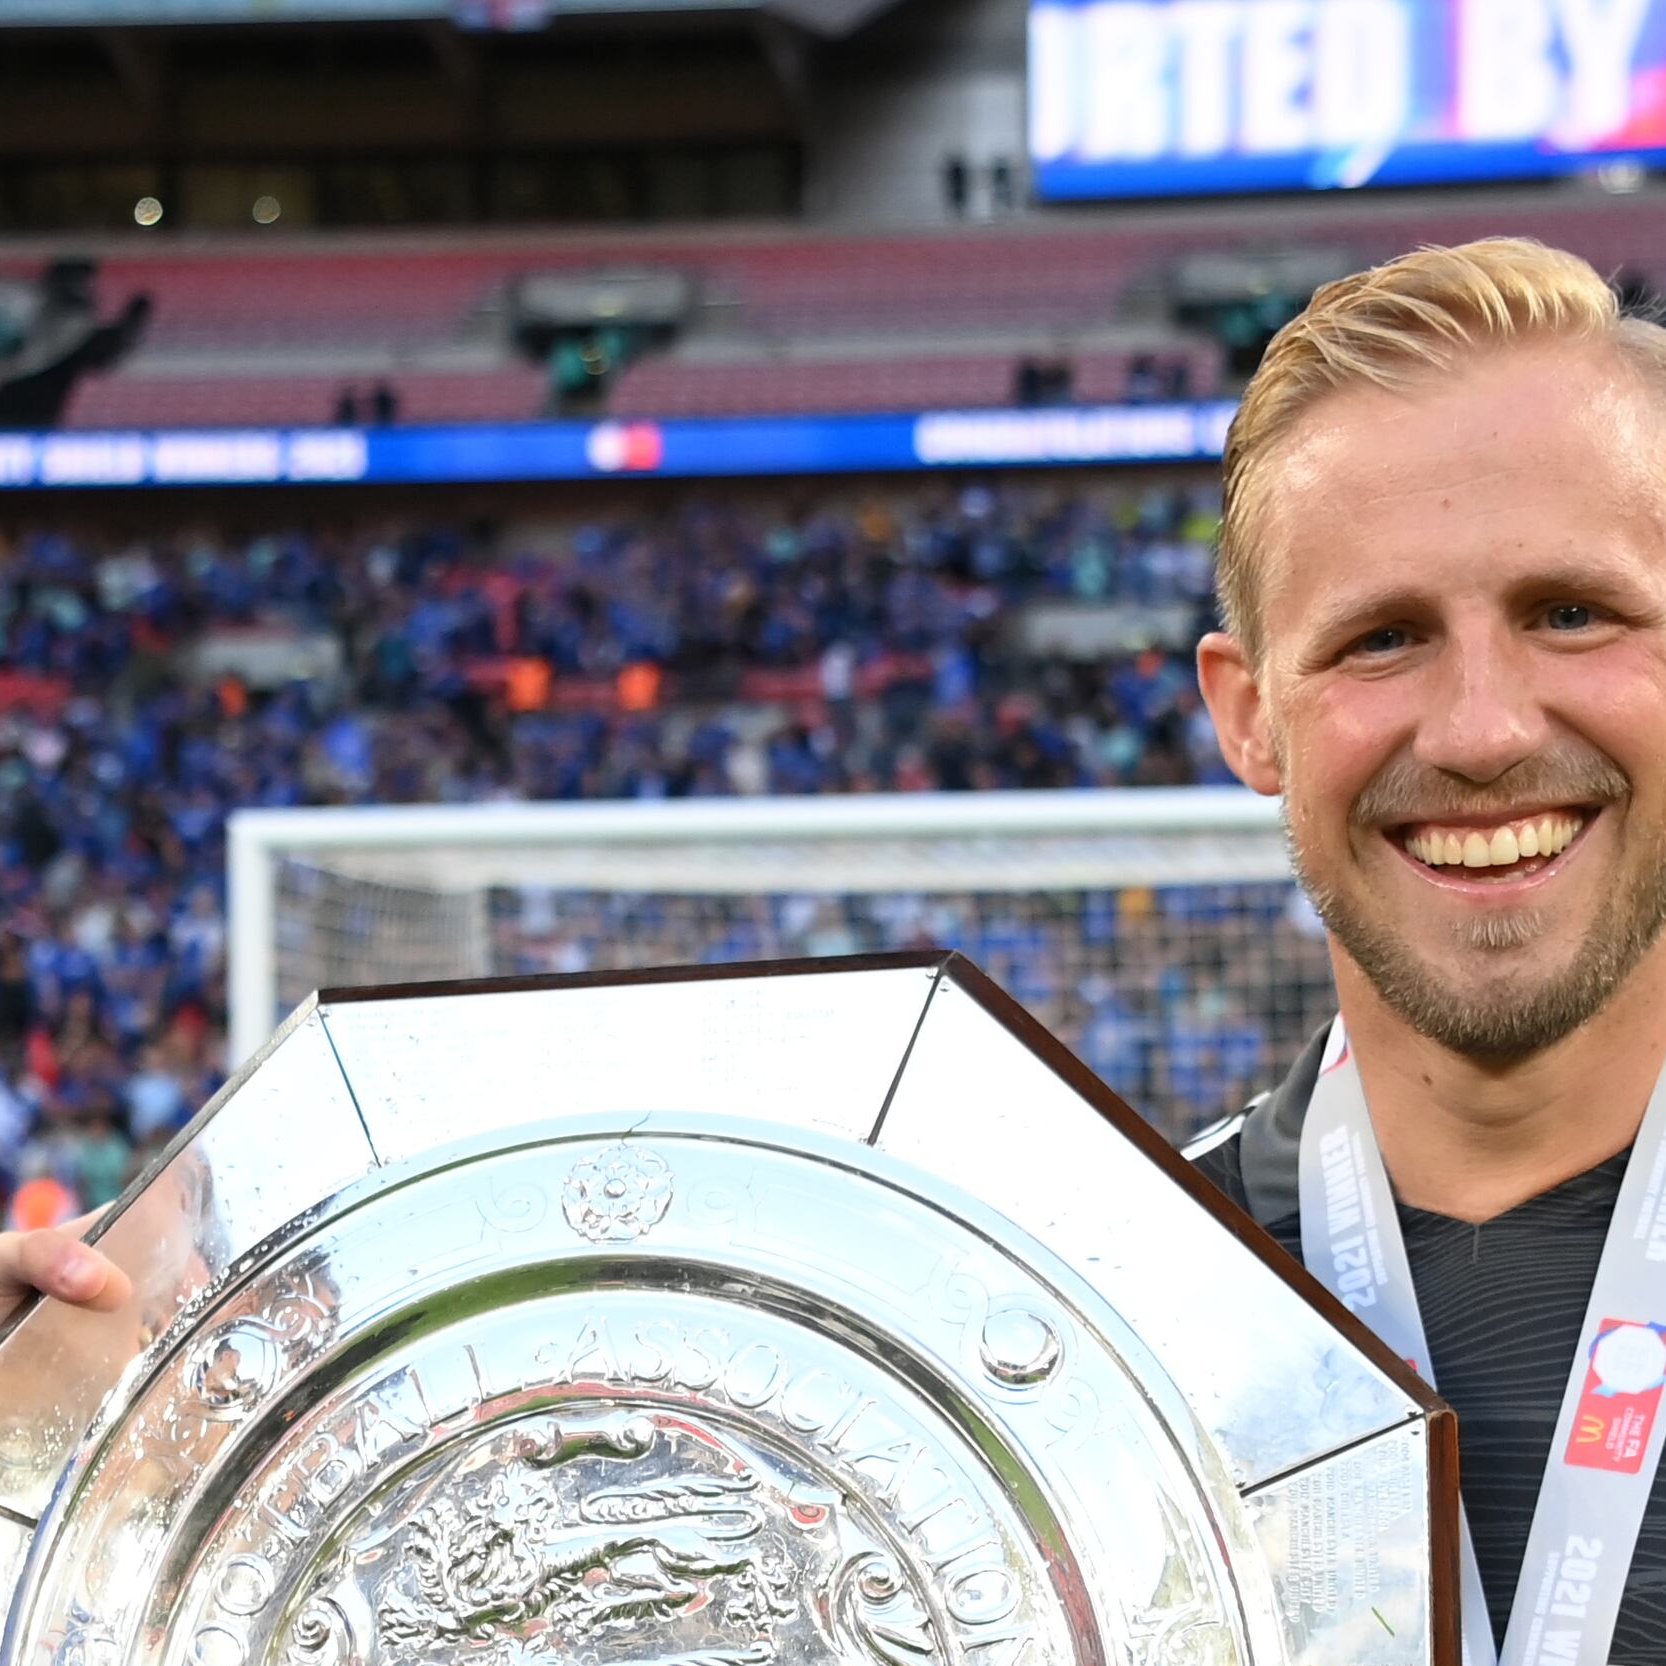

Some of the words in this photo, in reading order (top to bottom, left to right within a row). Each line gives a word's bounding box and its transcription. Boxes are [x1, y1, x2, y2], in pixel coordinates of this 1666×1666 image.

[1319, 1125, 1358, 1236] WINNER
[1330, 1234, 1377, 1310] 2021
[1555, 1535, 1603, 1618] 2021
